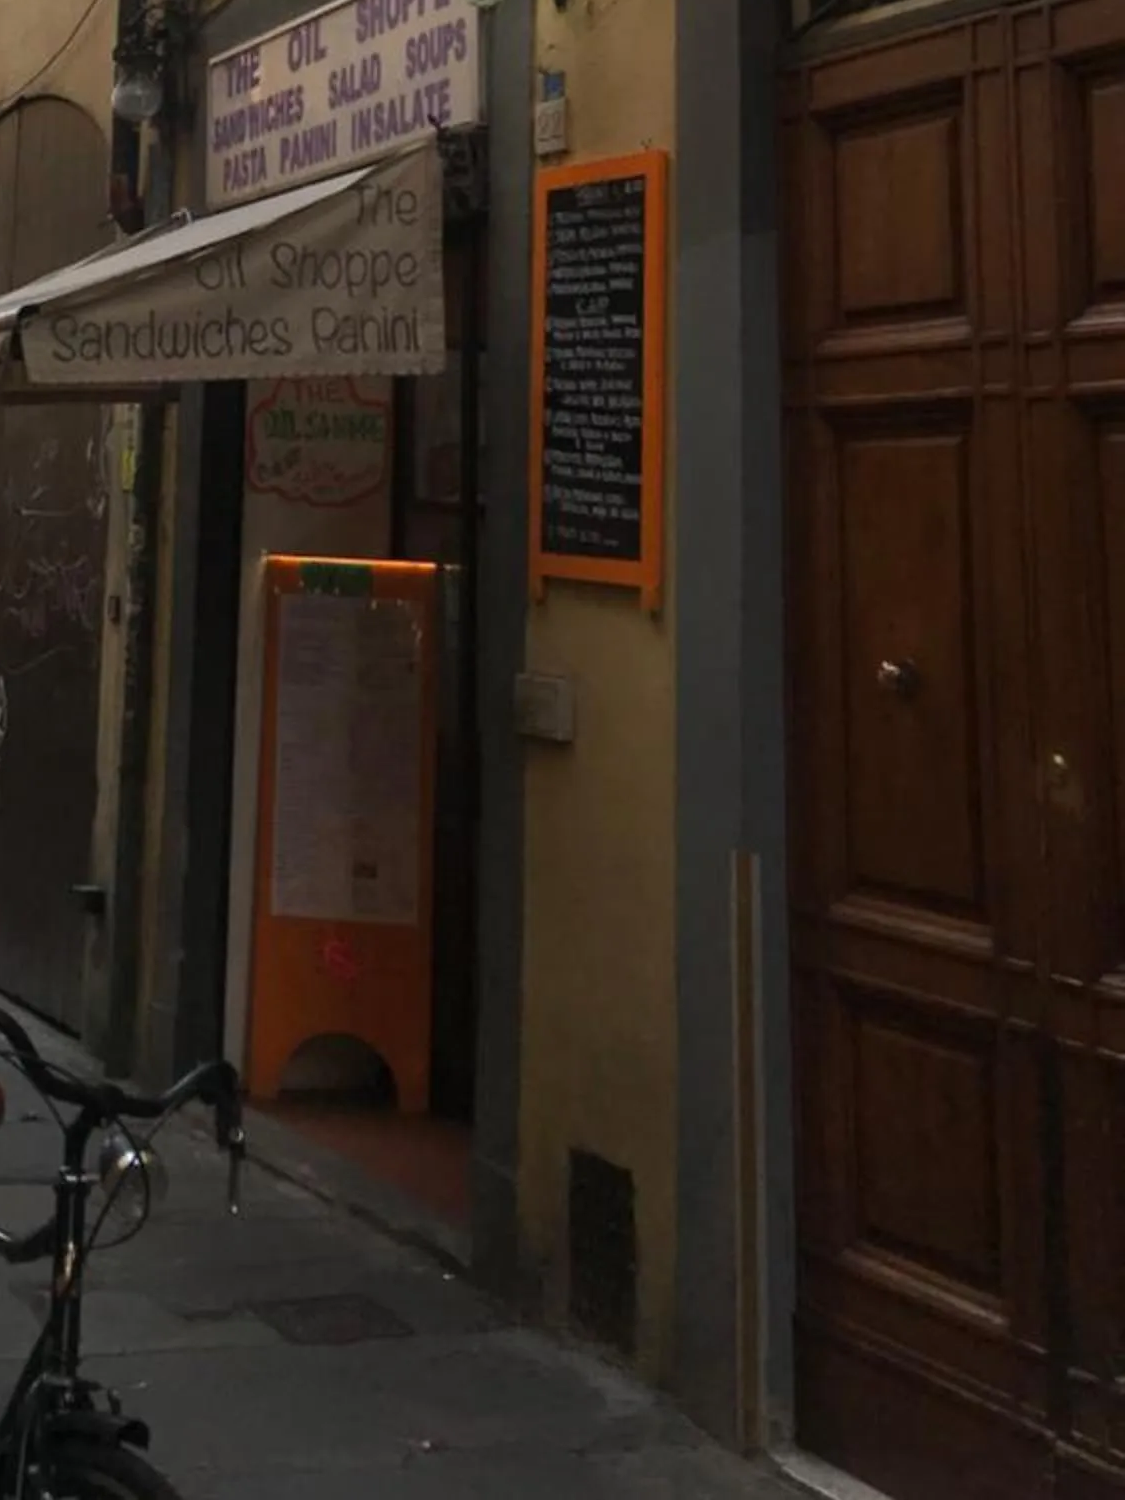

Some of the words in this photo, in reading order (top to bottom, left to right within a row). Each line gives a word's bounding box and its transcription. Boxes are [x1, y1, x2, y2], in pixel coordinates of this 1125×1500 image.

[214, 85, 304, 153] SANDWICHES
[328, 53, 381, 108] SALAD
[405, 18, 467, 79] SOUPS
[227, 50, 261, 97] THE
[288, 20, 328, 73] OIL
[223, 147, 267, 192] PASTA
[279, 120, 337, 175] PANINI
[352, 78, 452, 152] INSALATE
[347, 182, 419, 226] The
[269, 241, 418, 298] Shoppe
[49, 308, 294, 363] Sandwiches
[311, 306, 421, 355] Panini
